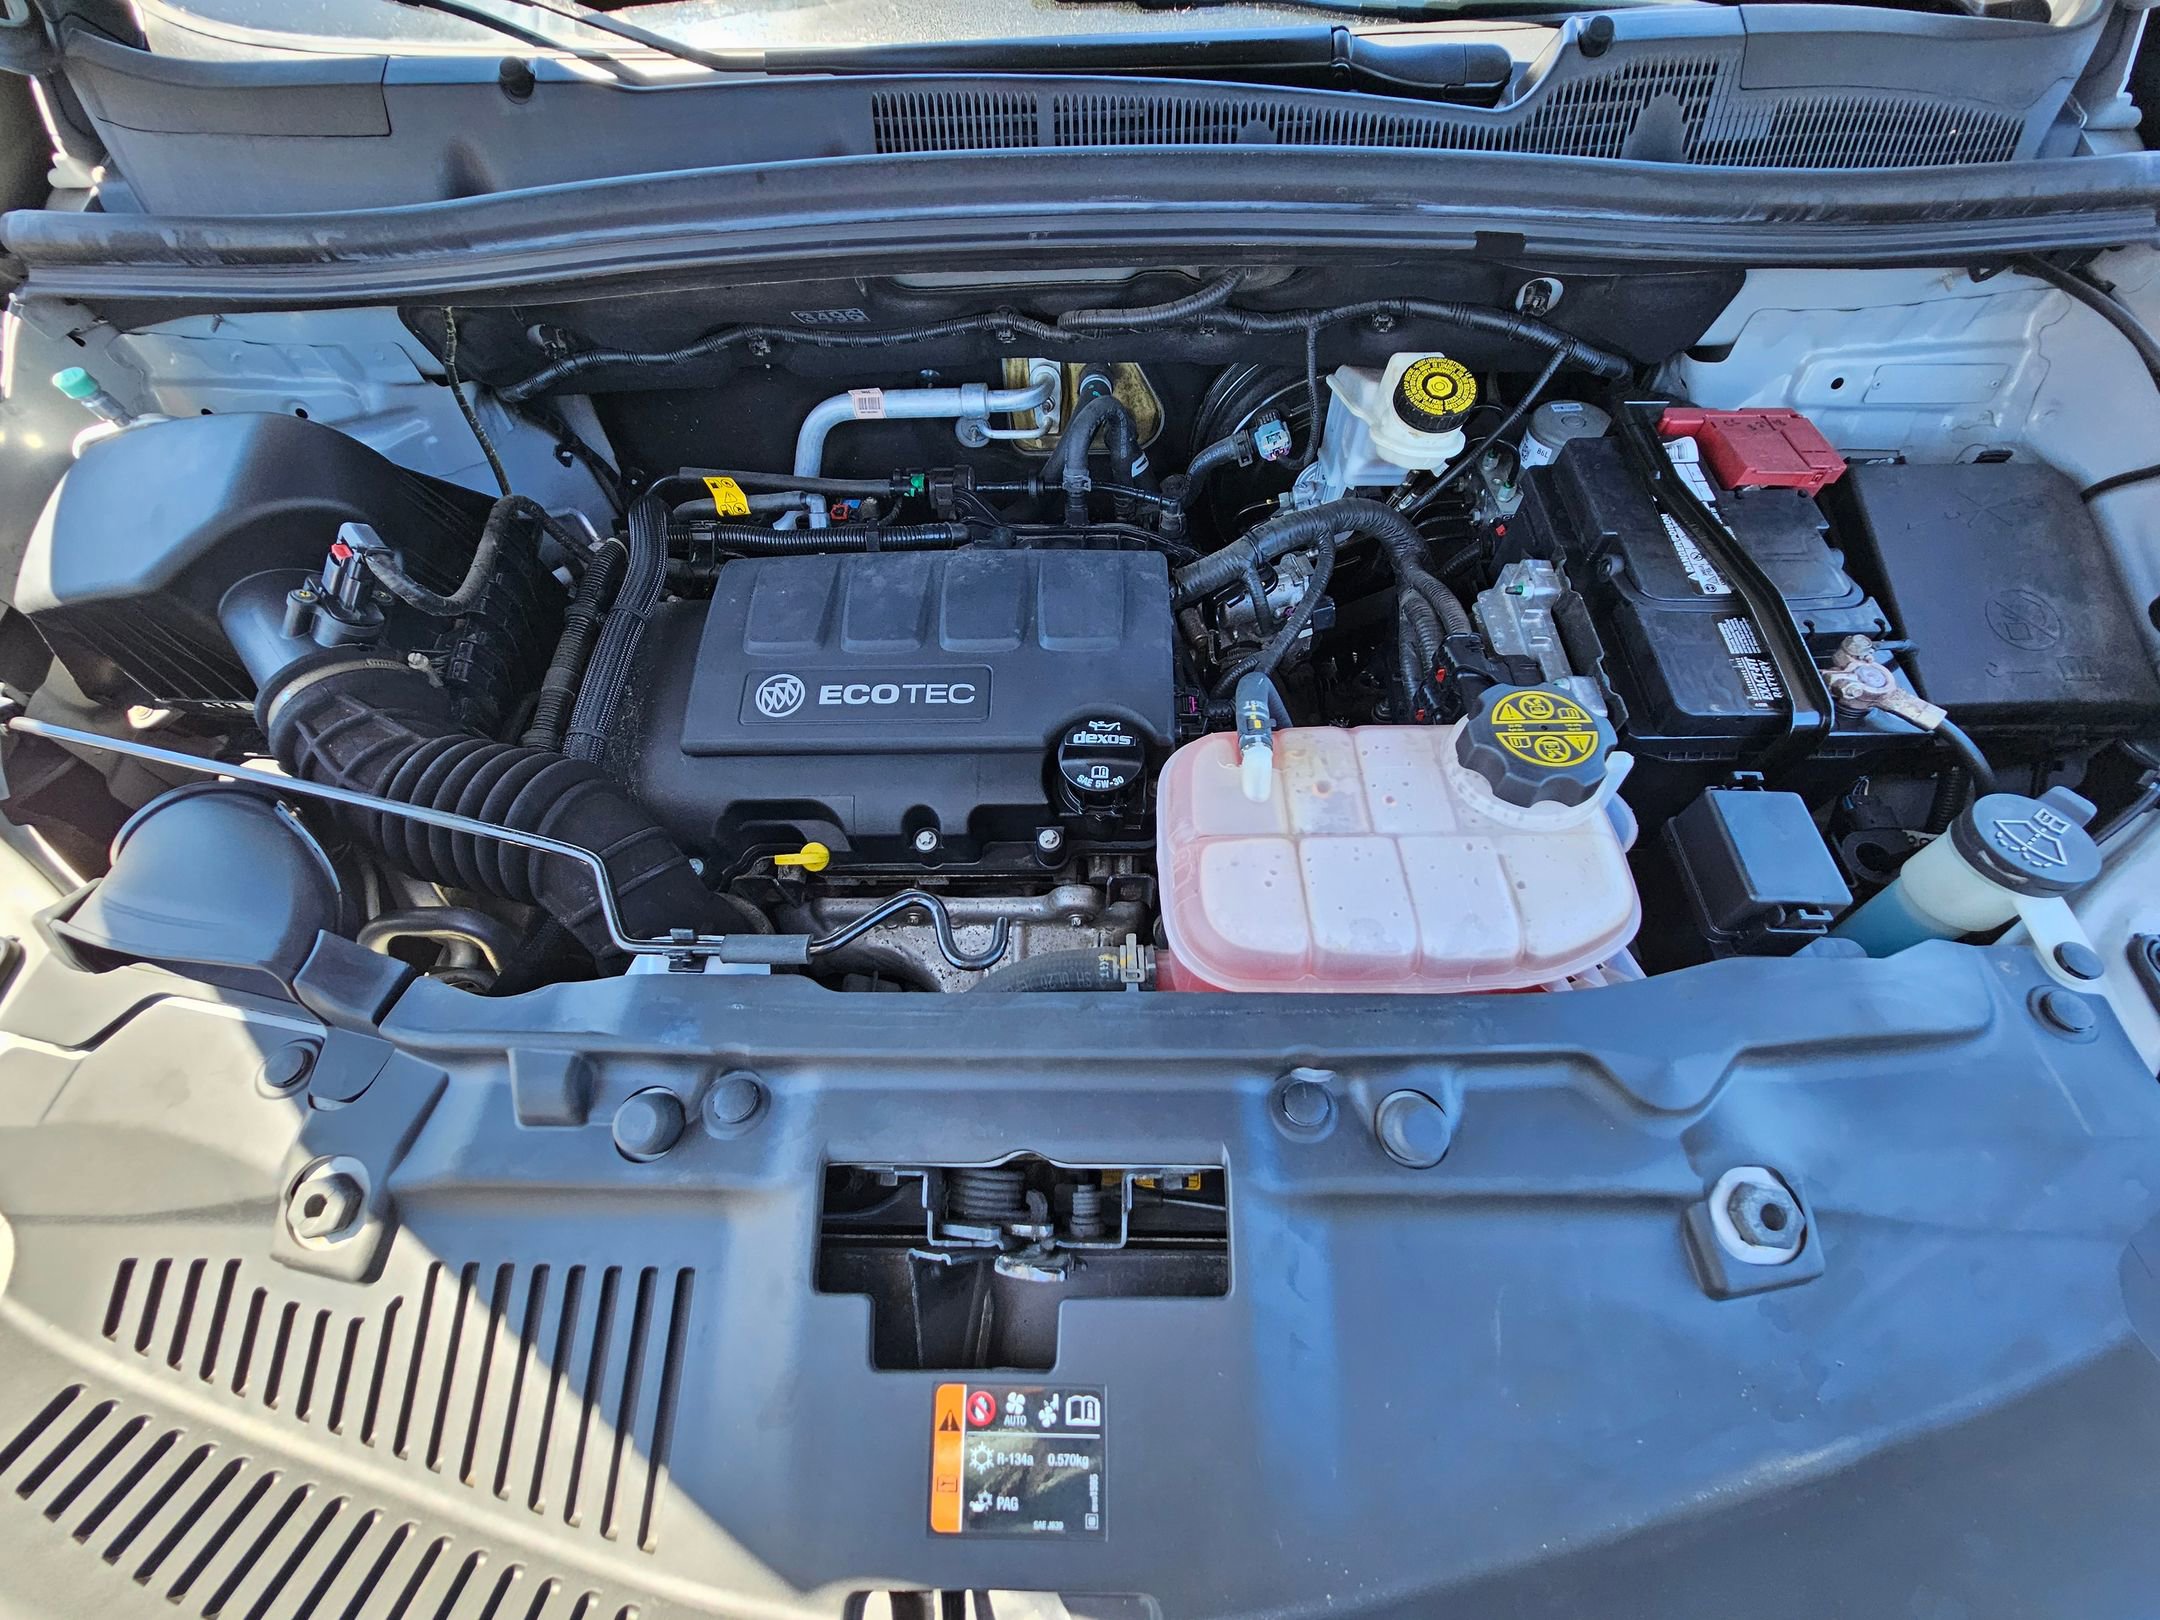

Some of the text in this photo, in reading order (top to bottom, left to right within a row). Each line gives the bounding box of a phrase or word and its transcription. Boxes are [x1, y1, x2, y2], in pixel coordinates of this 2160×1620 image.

[819, 683, 976, 704] ECOTEC
[1073, 731, 1133, 745] dexos
[1076, 774, 1125, 788] SAE 5W-30
[1004, 1415, 1027, 1426] AUTO
[997, 1453, 1089, 1469] R-134a 0.570kg
[996, 1496, 1019, 1511] PAG
